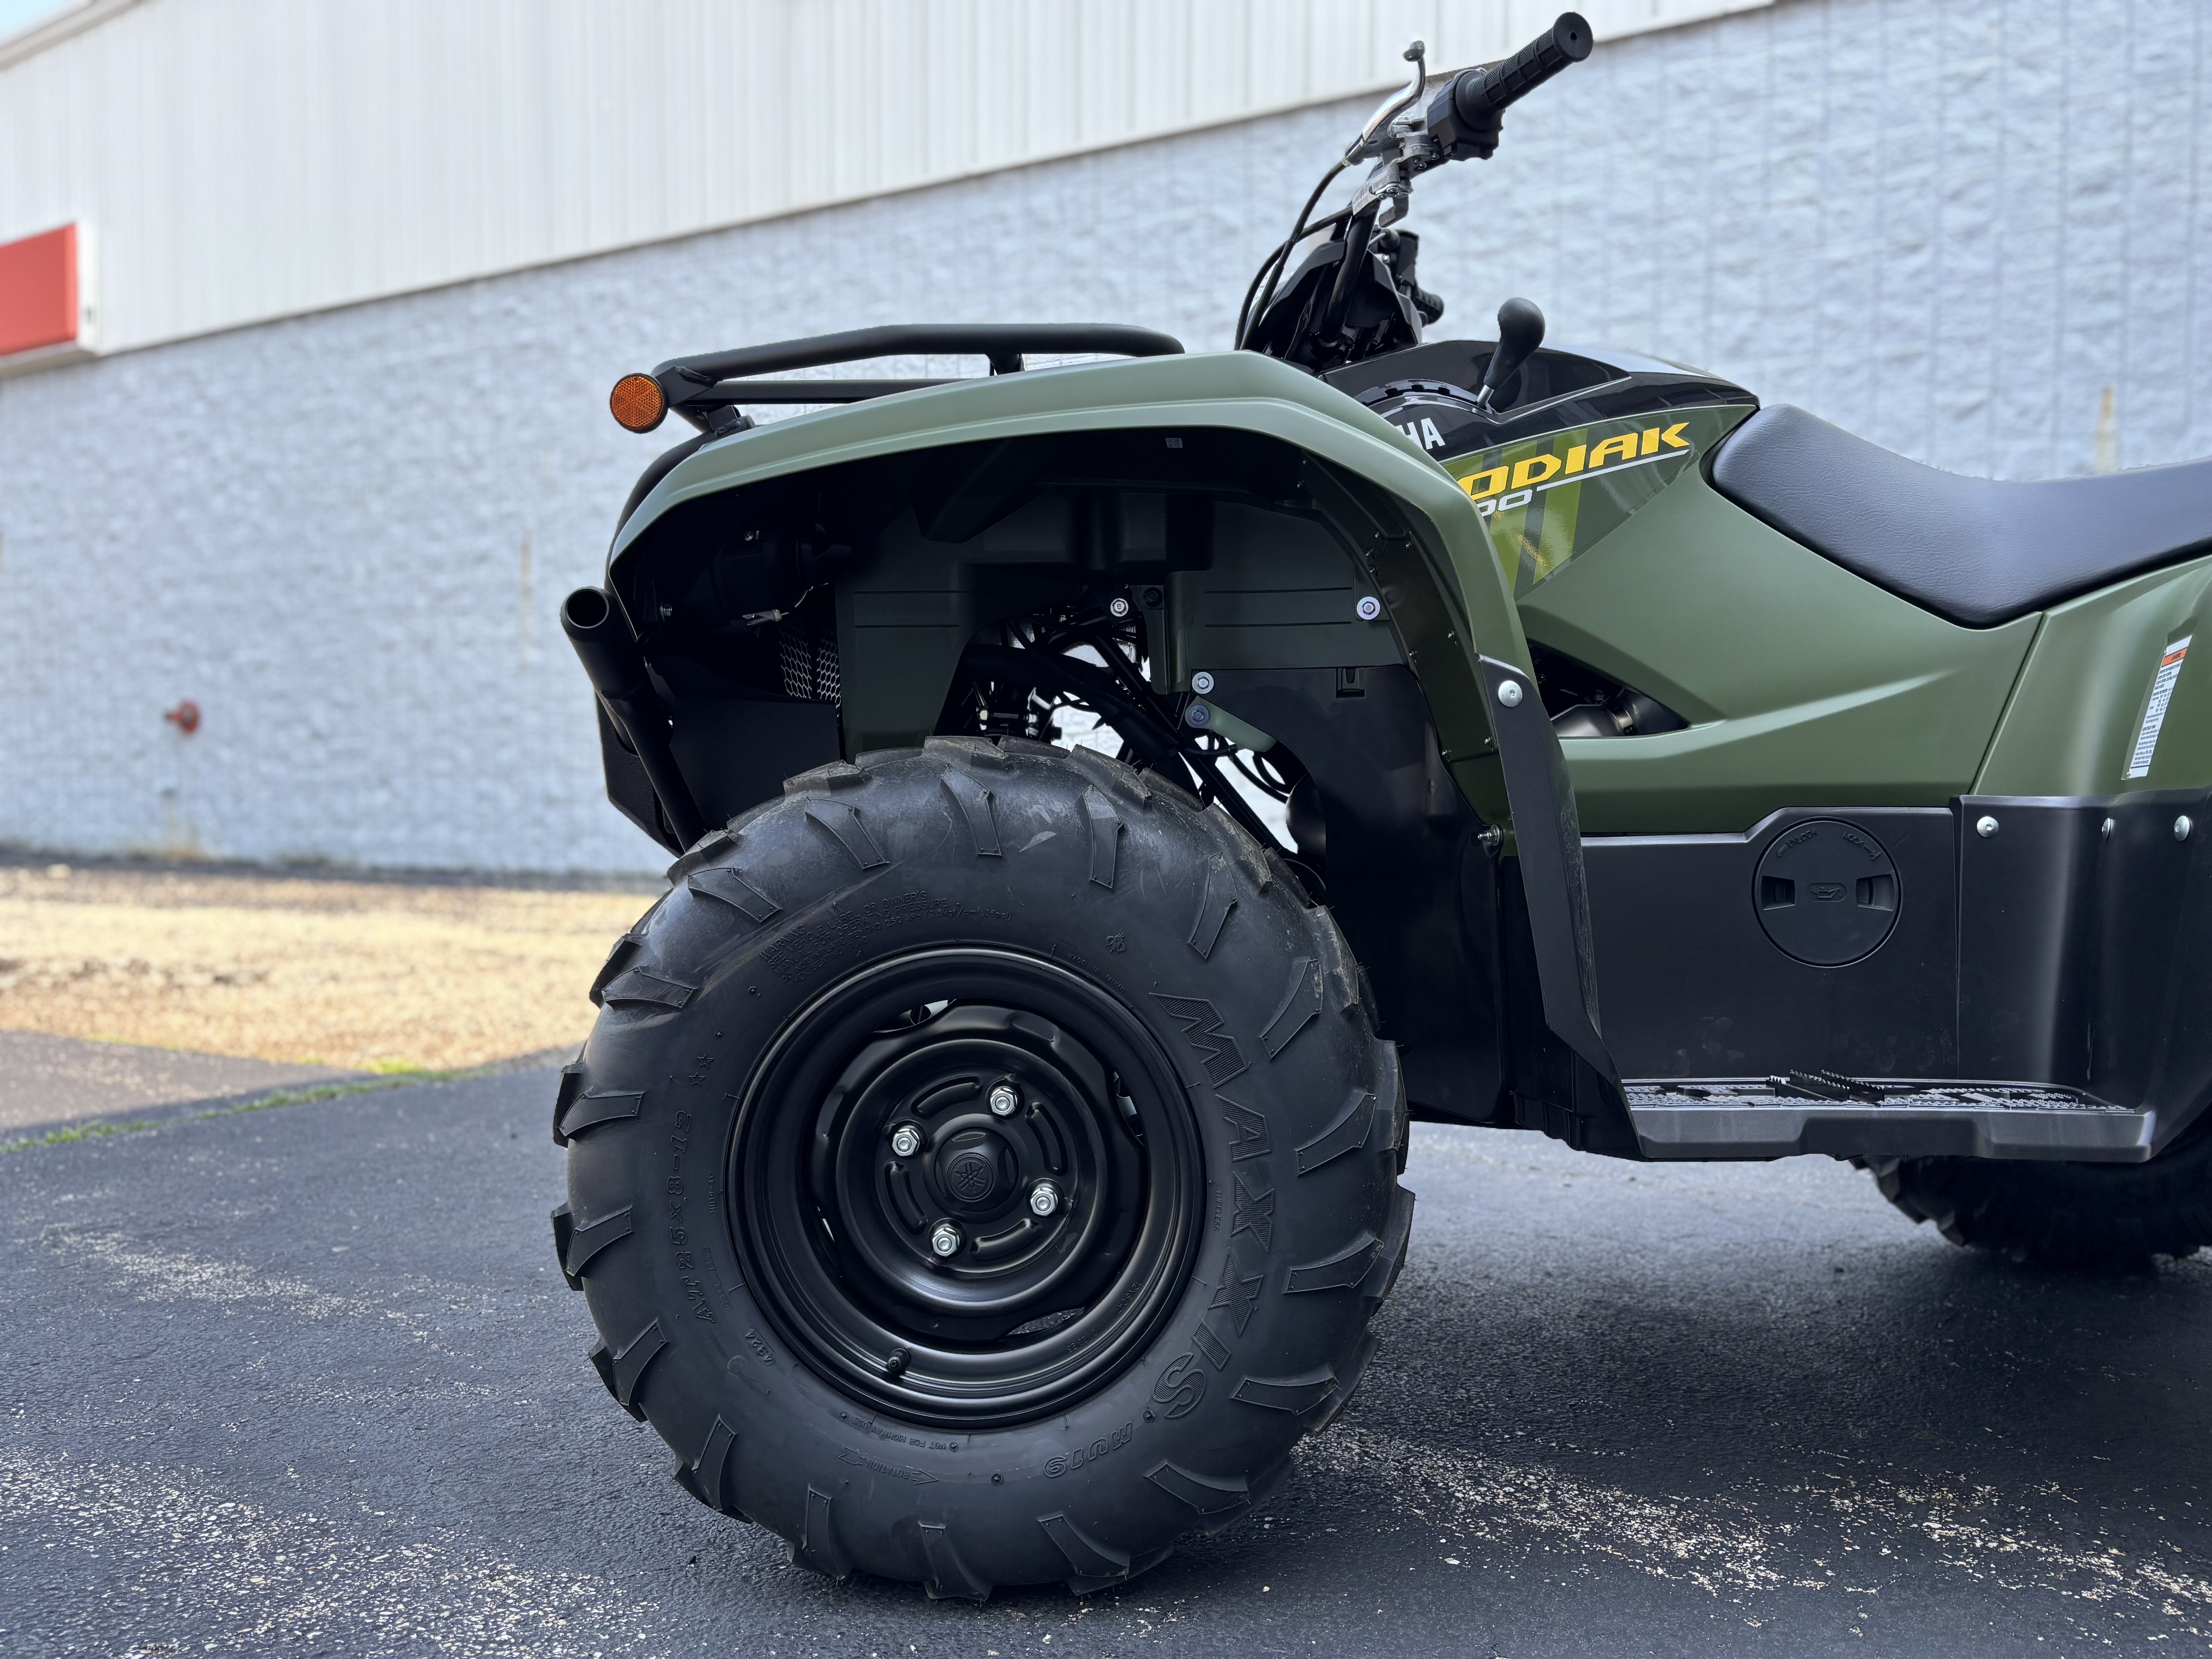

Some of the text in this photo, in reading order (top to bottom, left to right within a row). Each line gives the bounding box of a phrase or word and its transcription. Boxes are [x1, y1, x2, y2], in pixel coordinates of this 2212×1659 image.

[1786, 828, 1817, 848] UNLOCK
[1842, 831, 1865, 848] LOCK
[768, 890, 926, 968] SEE VEHICLE LABEL OR OWNER'S
[813, 932, 832, 948] FOR
[836, 908, 890, 935] OPERATING
[885, 916, 901, 926] 250
[906, 912, 921, 921] kPa
[760, 923, 805, 961] WARNING
[1068, 953, 1085, 965] MADE
[1105, 974, 1126, 991] TAIWAN
[1149, 992, 1276, 1419] MAXXIS
[1212, 1190, 1223, 1232] TUBELESS
[853, 1417, 946, 1450] NOT FOR HIGHWAY USE
[1043, 1421, 1133, 1478] MU19
[866, 1460, 909, 1479] ROTATION
